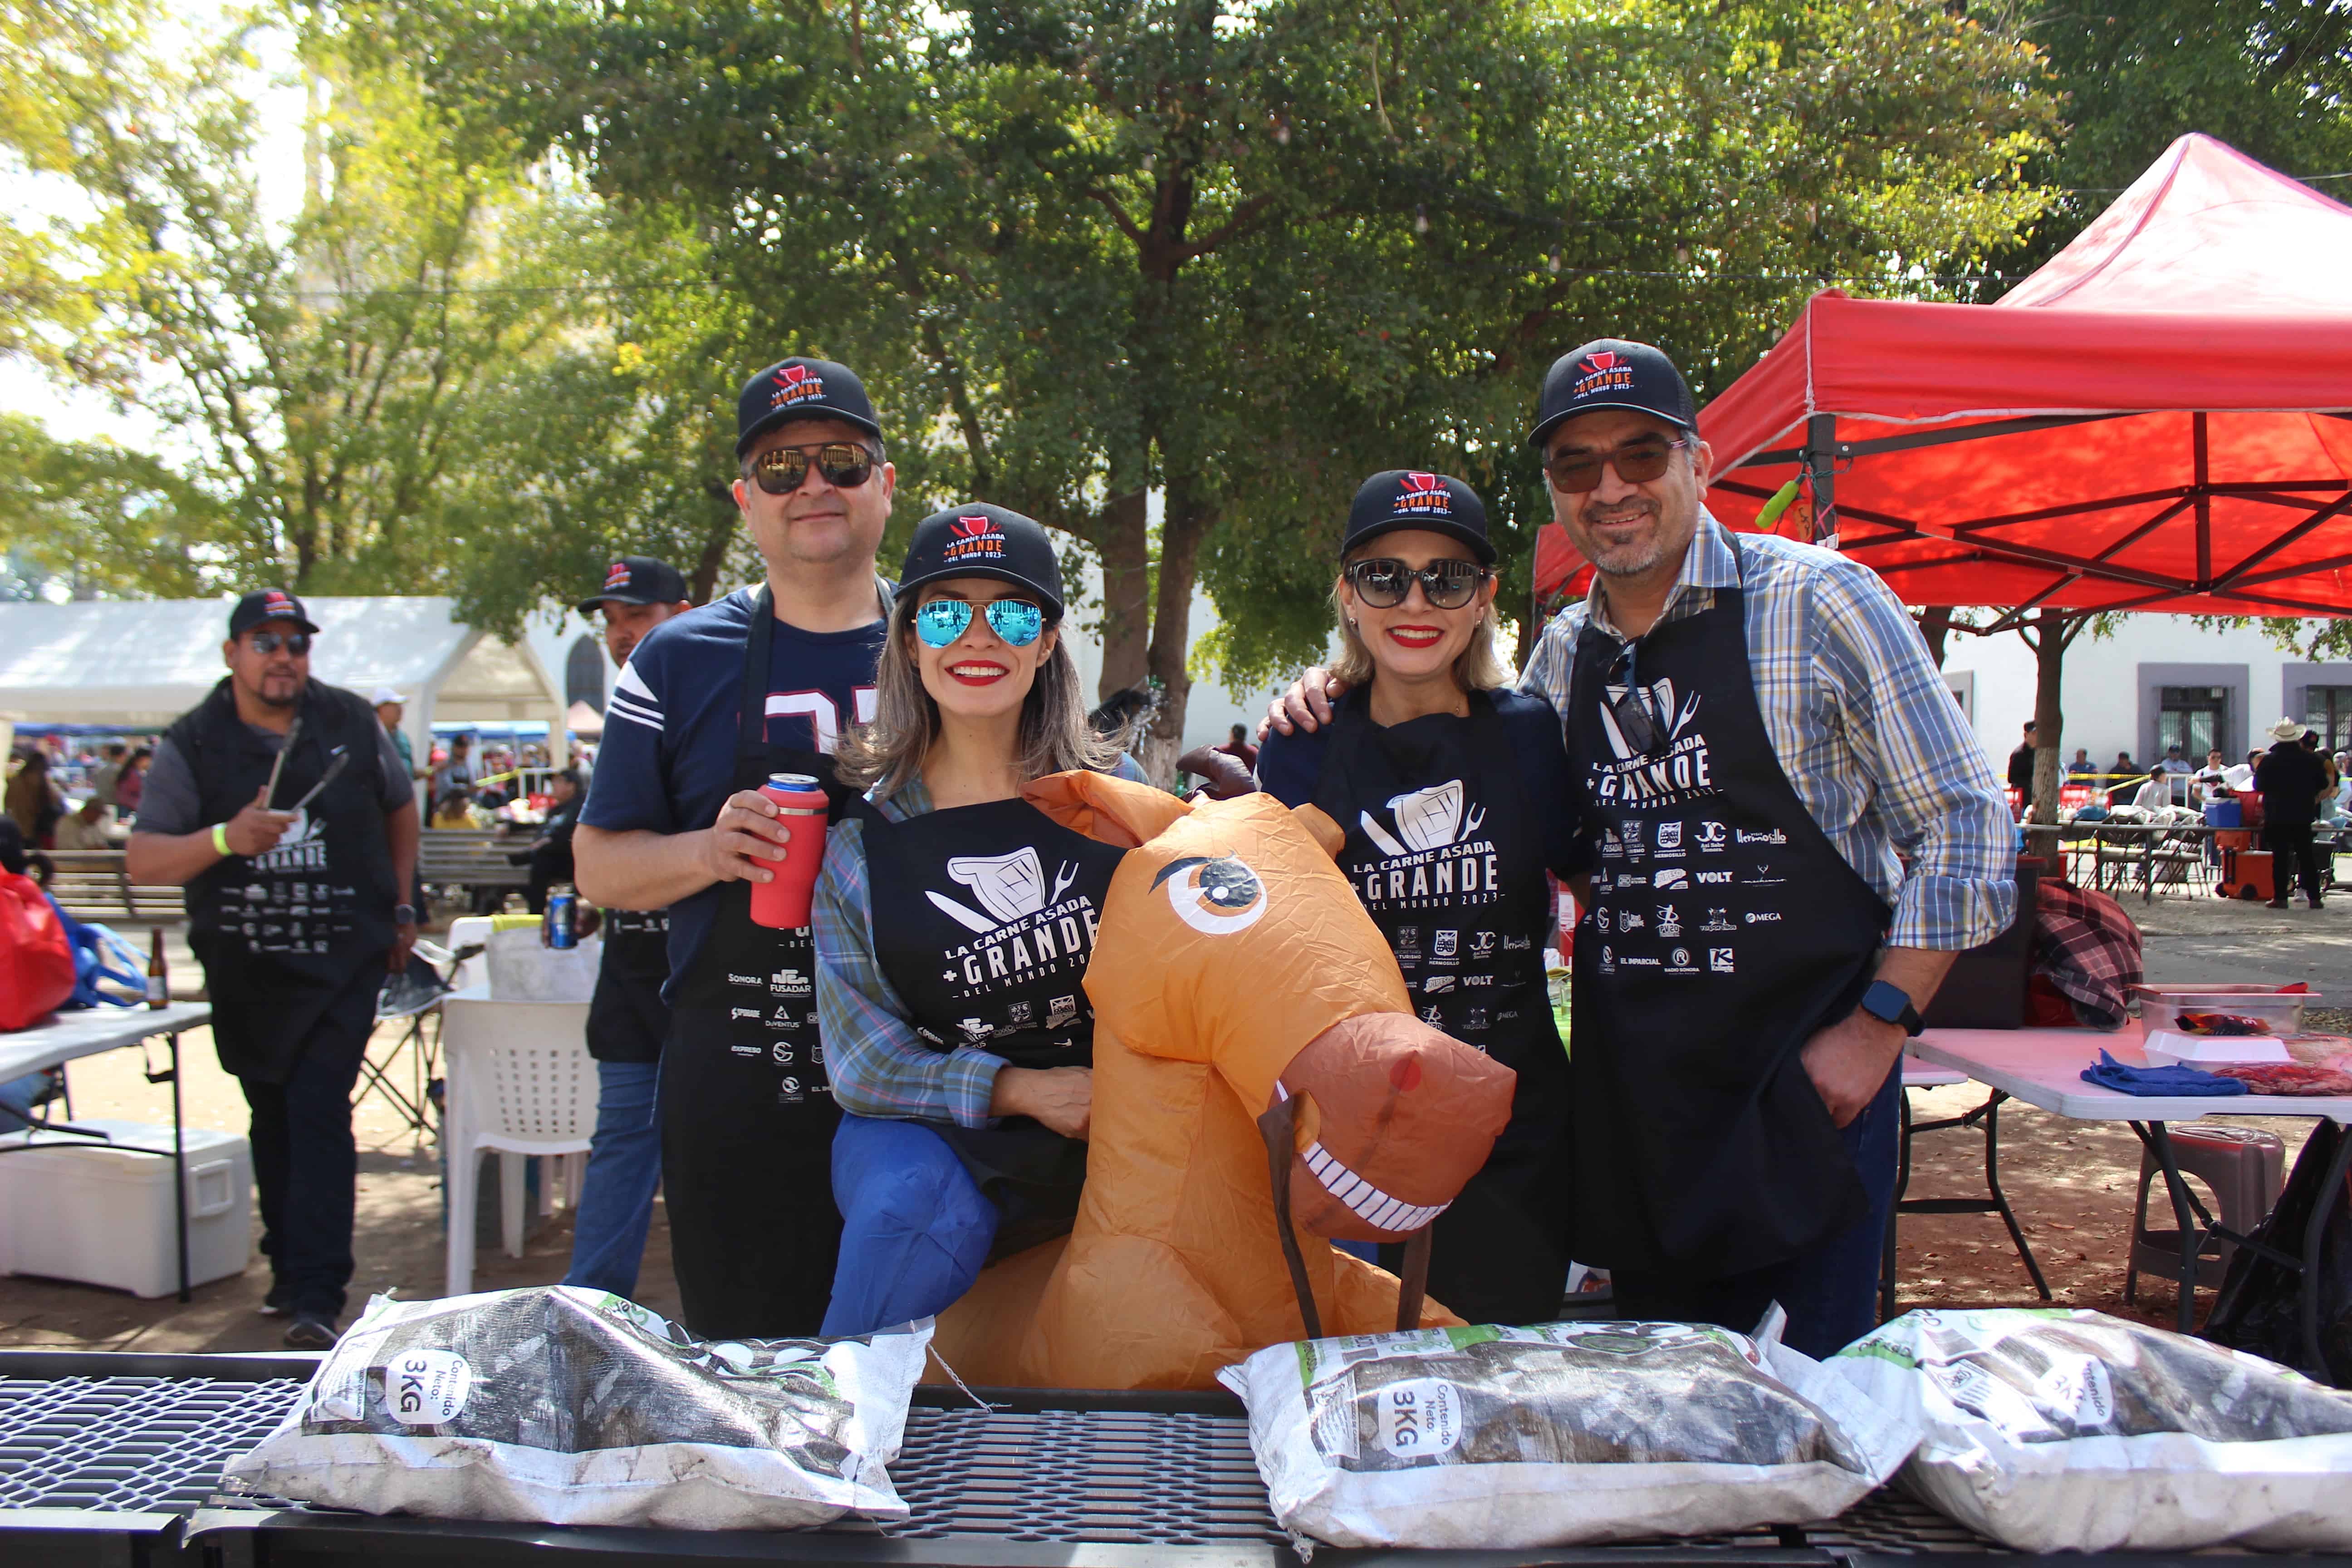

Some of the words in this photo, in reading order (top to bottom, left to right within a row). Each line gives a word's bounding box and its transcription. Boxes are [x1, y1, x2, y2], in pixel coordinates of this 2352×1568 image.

[1433, 506, 1447, 514] 2023
[956, 535, 980, 545] CARNE
[961, 551, 981, 559] MUNDO
[1592, 761, 1614, 774] LA
[1616, 754, 1649, 773] CARNE
[1630, 794, 1677, 809] MUNDO
[1736, 828, 1787, 843] Hermosillo
[1353, 863, 1376, 874] LA
[1380, 851, 1435, 872] CARNE
[1440, 840, 1496, 860] ASADA
[1695, 871, 1733, 883] VOLT
[1400, 896, 1449, 909] MUNDO
[1462, 892, 1498, 906] 2023
[944, 945, 970, 960] LA
[973, 917, 1031, 951] CARNE
[1035, 895, 1093, 926] ASADA
[1628, 957, 1662, 965] IMPARCIAL
[728, 973, 763, 985] SONORA
[964, 984, 992, 998] DEL
[1004, 963, 1057, 987] MUNDO
[1068, 954, 1085, 968] 20
[1462, 975, 1494, 986] VOLT
[770, 984, 811, 993] FUSADAR
[430, 1369, 447, 1401] Neto:
[442, 1359, 464, 1417] Contenido
[1393, 1391, 1419, 1447] 3KG
[1424, 1400, 1435, 1433] Neto:
[1436, 1384, 1453, 1446] Contenido
